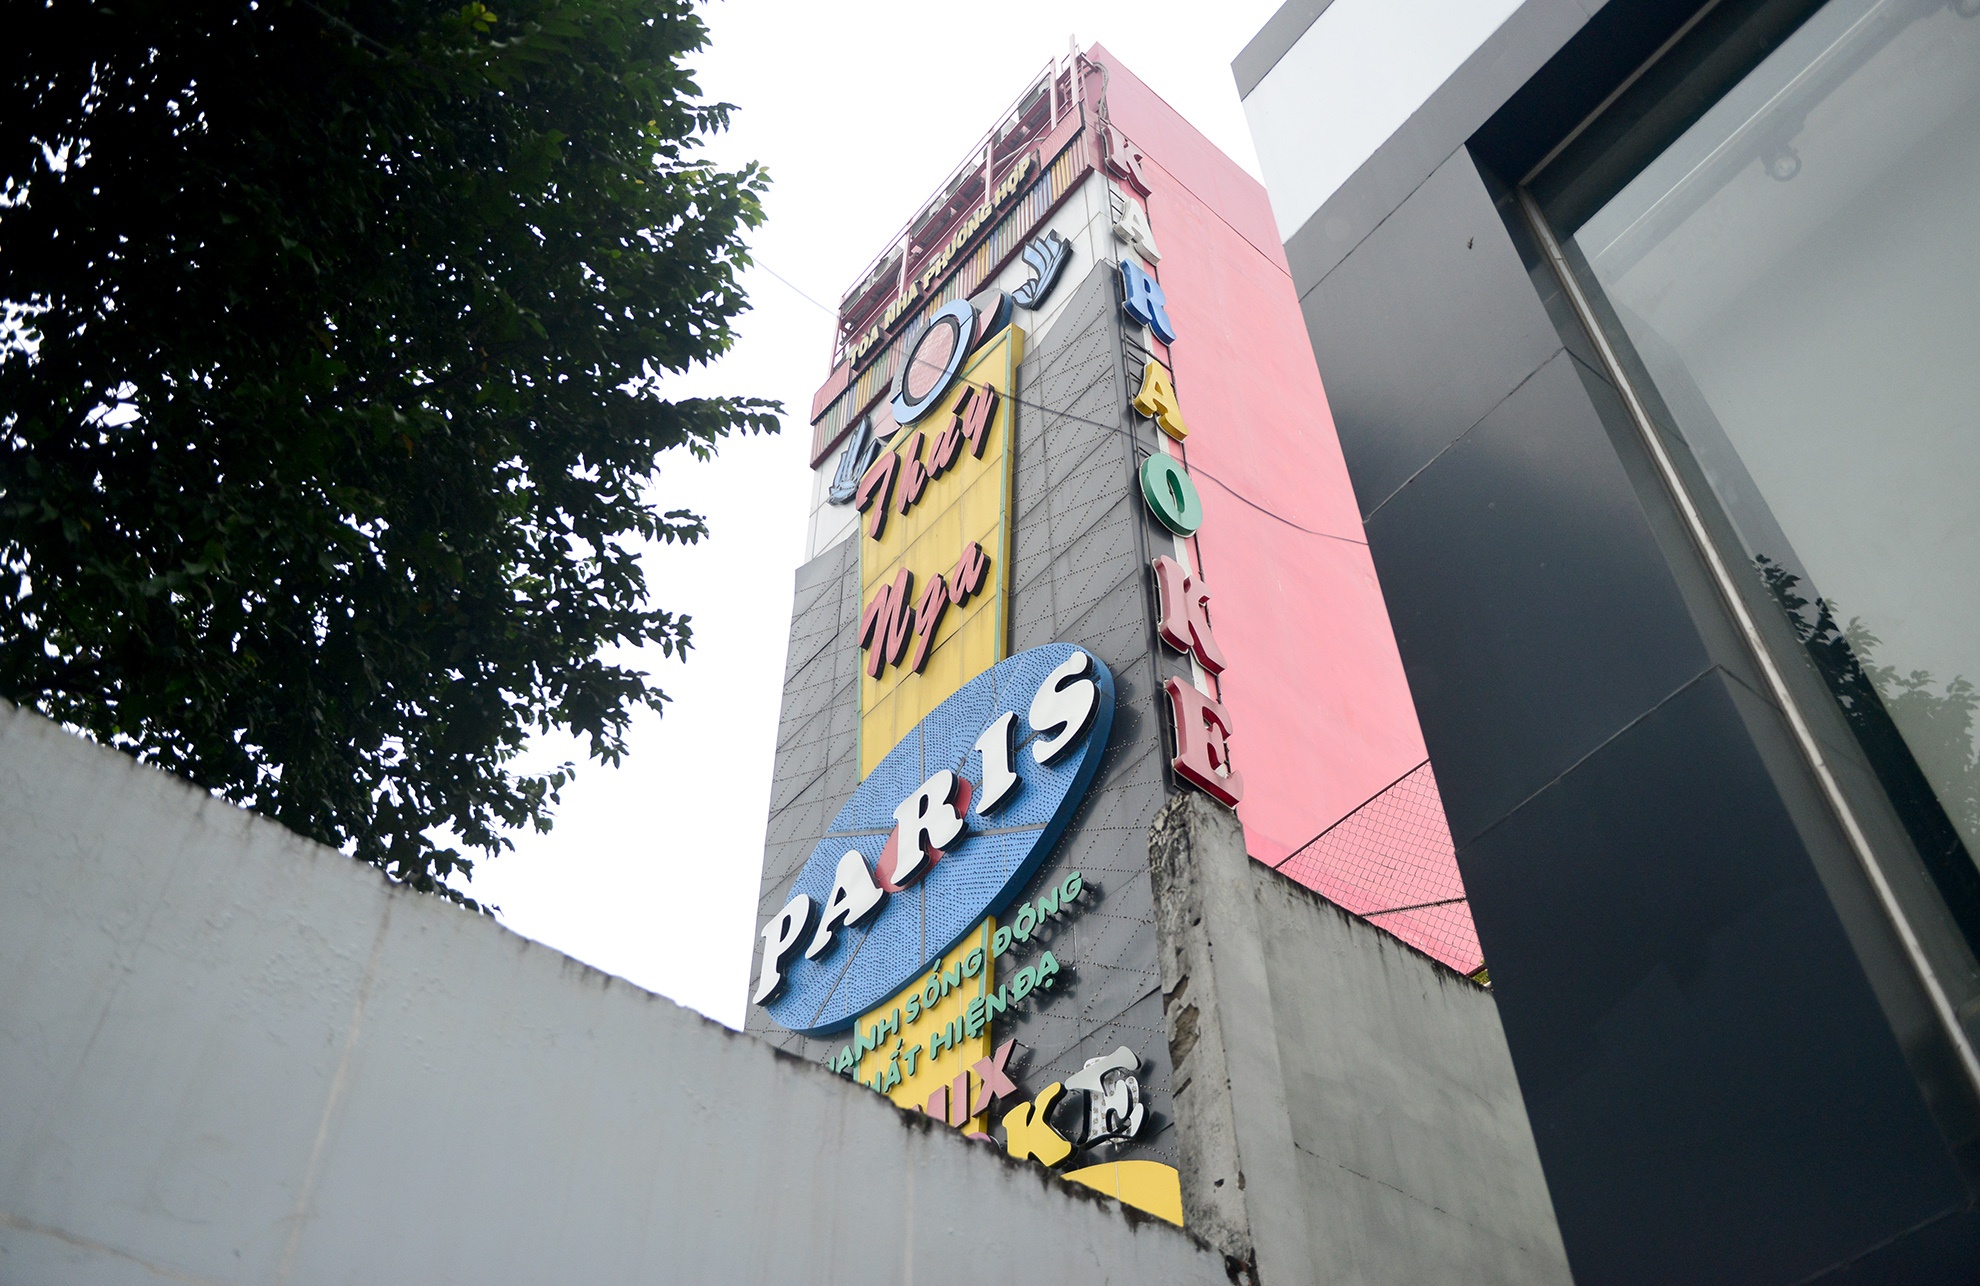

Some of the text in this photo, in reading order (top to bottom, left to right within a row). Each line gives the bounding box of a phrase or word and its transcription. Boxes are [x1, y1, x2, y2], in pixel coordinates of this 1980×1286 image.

[1101, 123, 1244, 810] KARAOKE
[858, 540, 991, 680] Nga
[752, 651, 1099, 1005] PARIS
[905, 947, 983, 1024] SỐNG
[991, 870, 1083, 959] ĐỘNG
[929, 984, 1008, 1061] HIỆN
[967, 1045, 1148, 1168] KE
